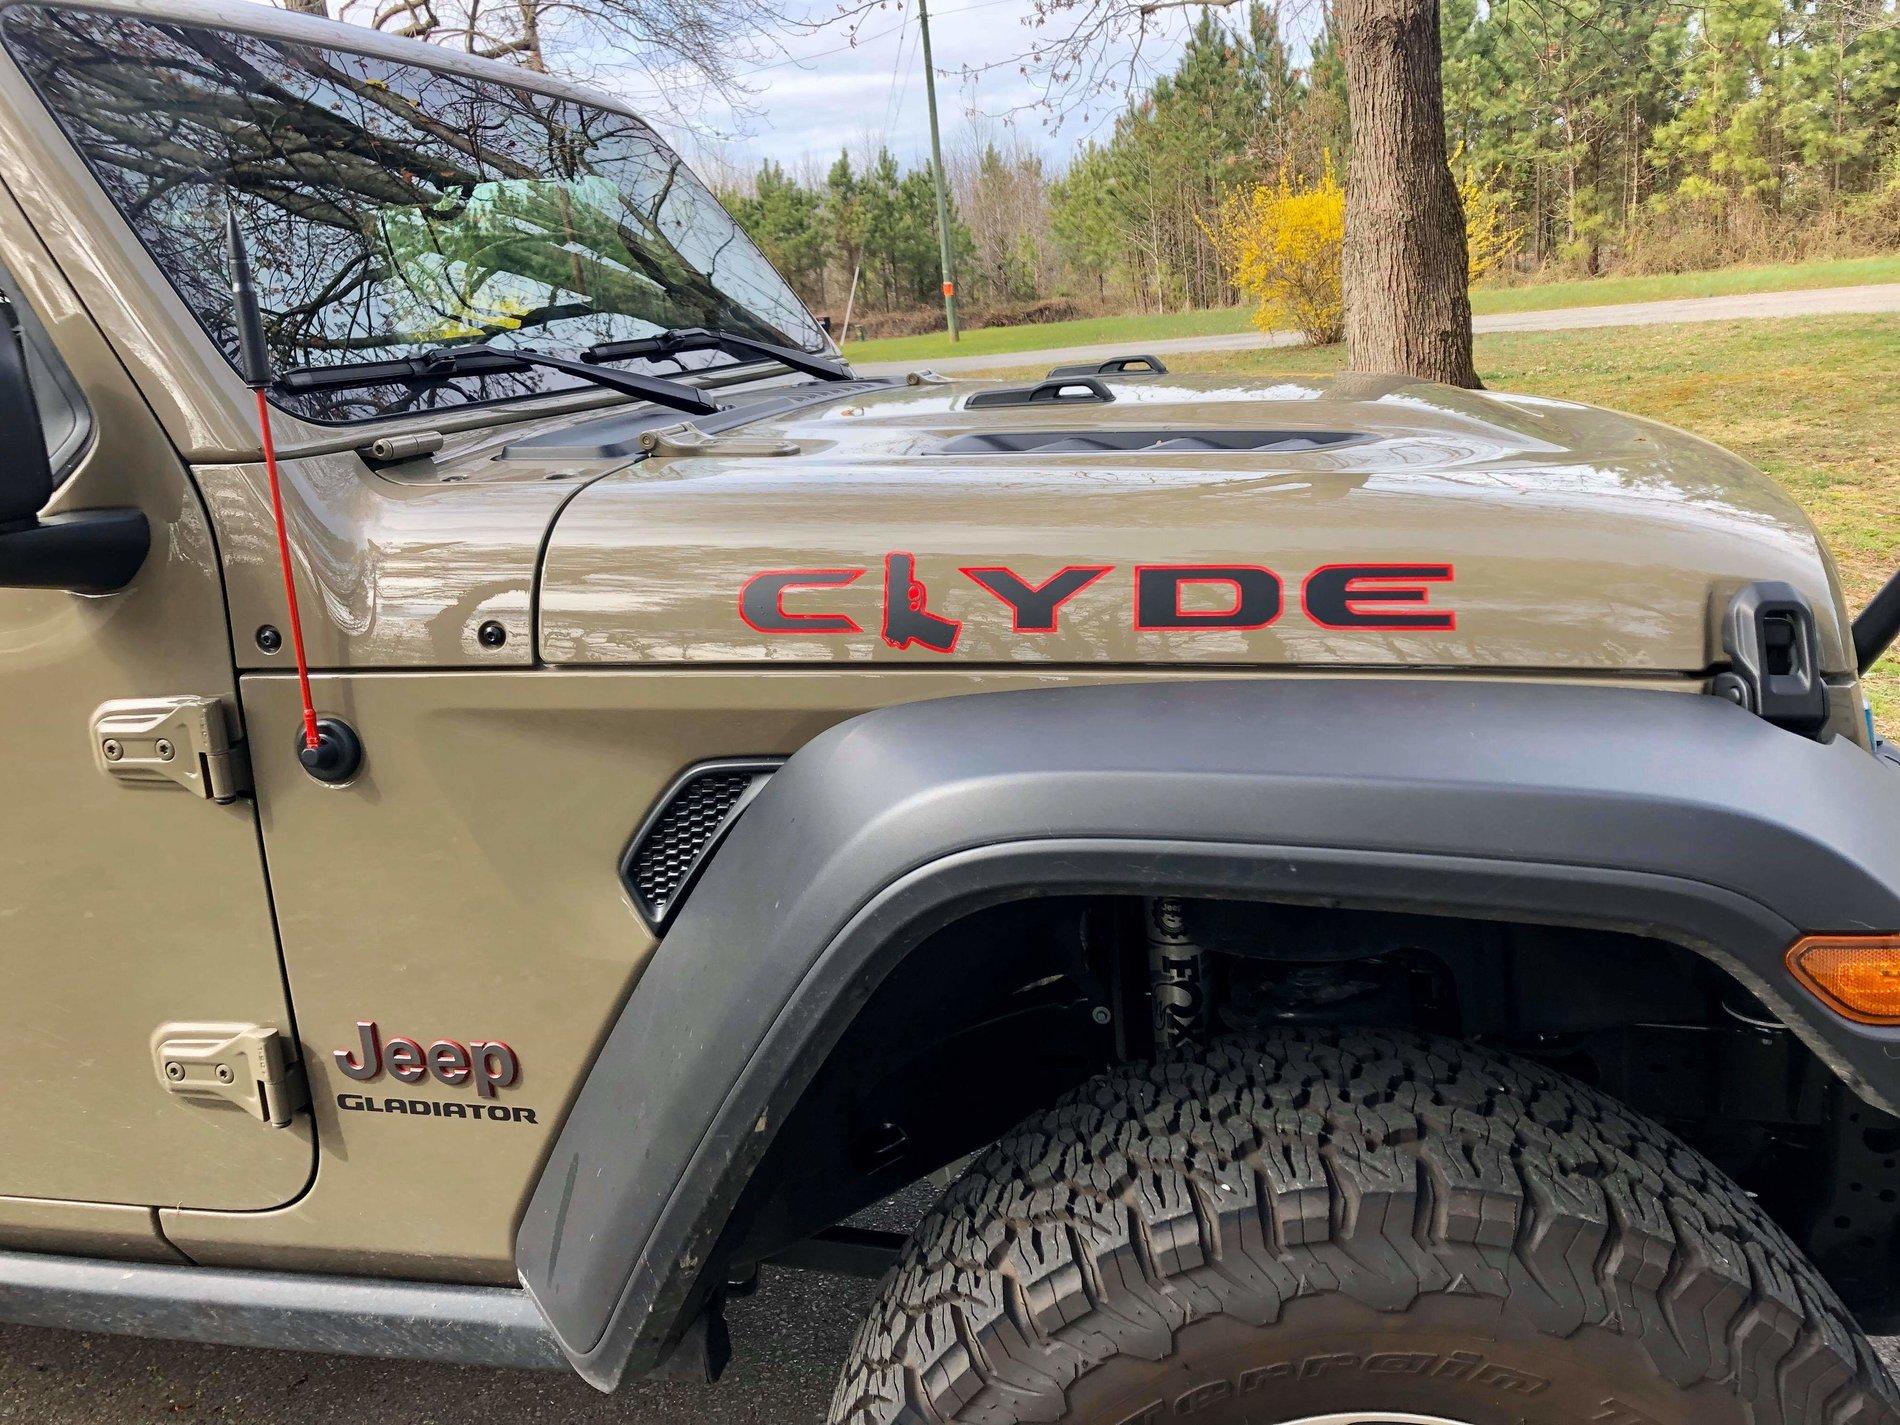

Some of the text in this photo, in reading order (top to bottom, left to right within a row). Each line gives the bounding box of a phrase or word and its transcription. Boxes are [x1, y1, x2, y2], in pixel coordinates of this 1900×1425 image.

[738, 551, 1456, 654] CLYDE
[333, 1020, 519, 1098] Jeep
[336, 1093, 540, 1125] GLADIATOR
